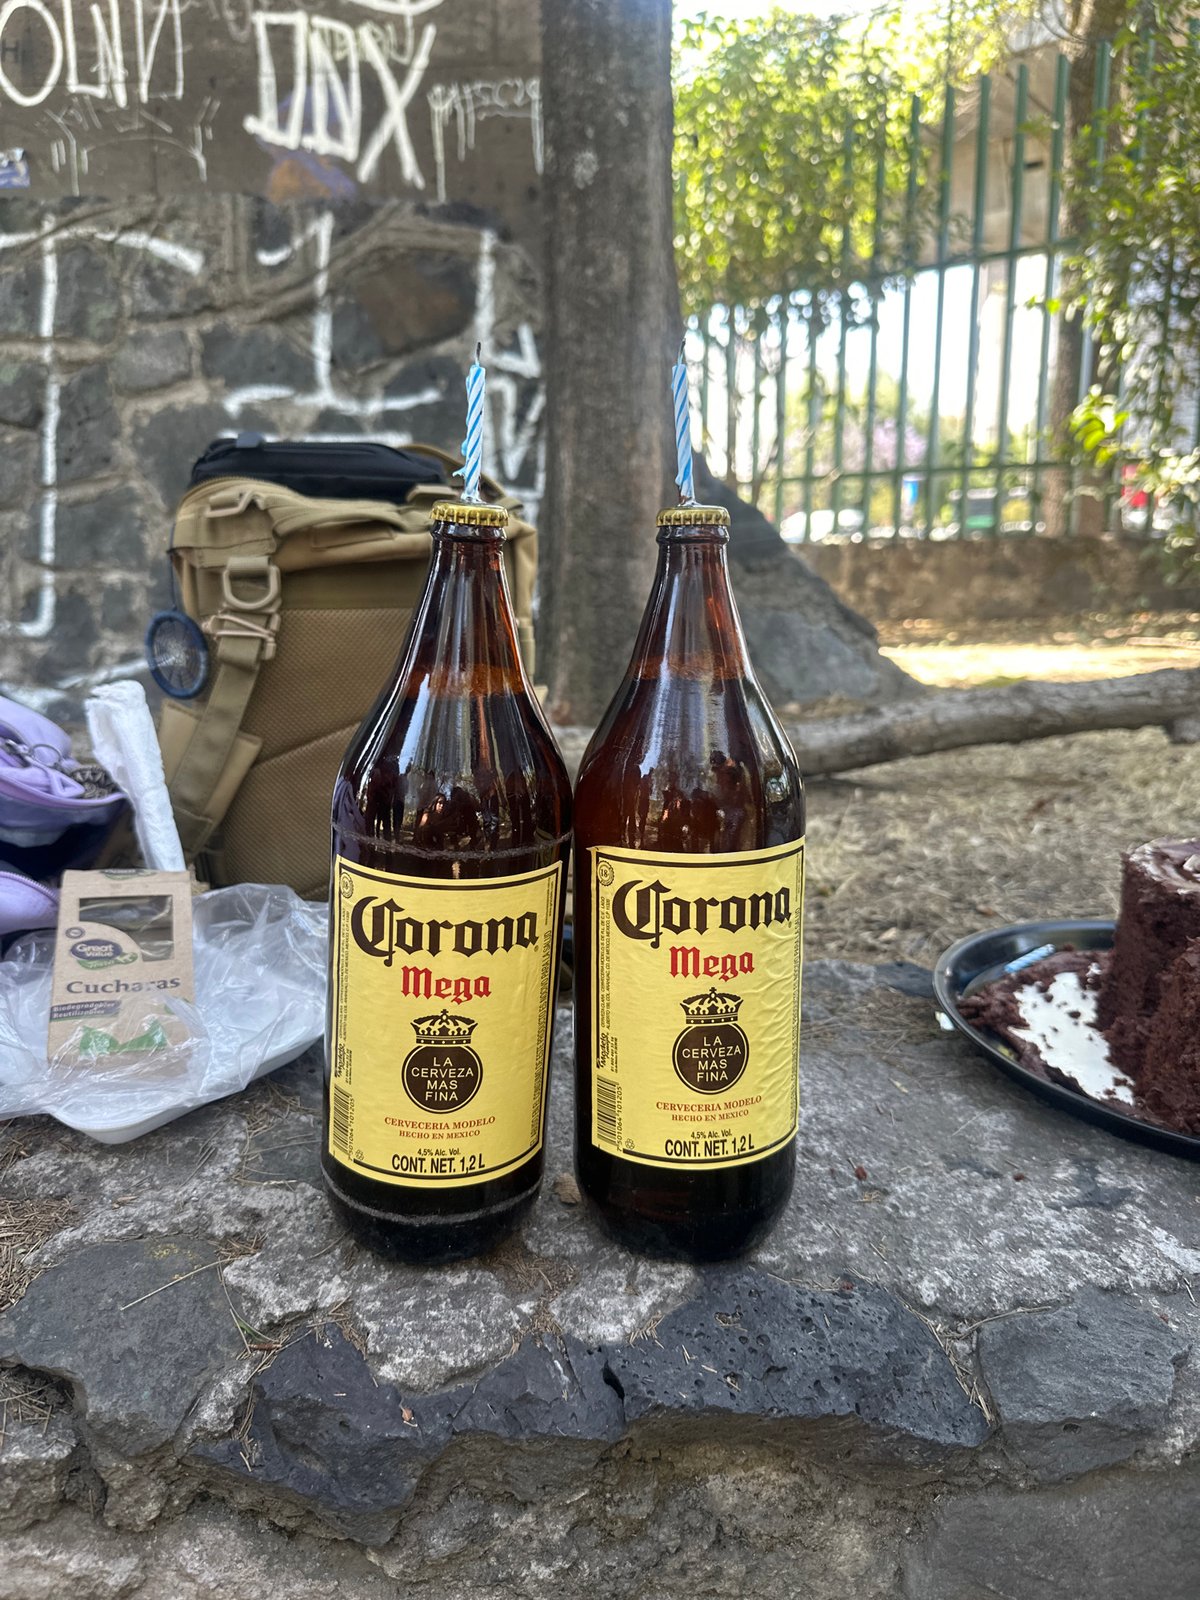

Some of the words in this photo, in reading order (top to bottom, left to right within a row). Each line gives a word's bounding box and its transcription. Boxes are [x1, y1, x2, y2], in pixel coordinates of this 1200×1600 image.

[612, 879, 792, 949] Corona
[351, 895, 539, 967] Corona
[669, 945, 755, 982] Mega
[66, 977, 181, 994] Cucharas
[401, 965, 492, 1005] Mega
[704, 1036, 722, 1046] LA
[682, 1045, 741, 1058] CERVEZA
[434, 1057, 453, 1067] LA
[698, 1059, 728, 1071] MAS
[411, 1067, 474, 1078] CERVEZA
[697, 1070, 728, 1082] FINA
[427, 1080, 458, 1090] MAS
[425, 1092, 458, 1101] FINA
[656, 1101, 721, 1112] CERVECERIA
[724, 1095, 762, 1110] MODELO
[719, 1110, 749, 1120] MEXICO
[384, 1117, 450, 1130] CERVECERIA
[452, 1116, 496, 1129] MODELO
[399, 1130, 430, 1139] HECHO
[446, 1130, 480, 1139] MEXICO
[708, 1130, 720, 1138] Alc.
[721, 1129, 732, 1137] Vol.
[665, 1139, 700, 1157] CONT.
[704, 1139, 728, 1156] NET.
[732, 1136, 746, 1155] 1,2
[749, 1133, 754, 1149] L
[392, 1154, 427, 1173] CONT.
[430, 1157, 456, 1173] NET.
[460, 1155, 475, 1174] 1,2
[479, 1153, 485, 1168] L
